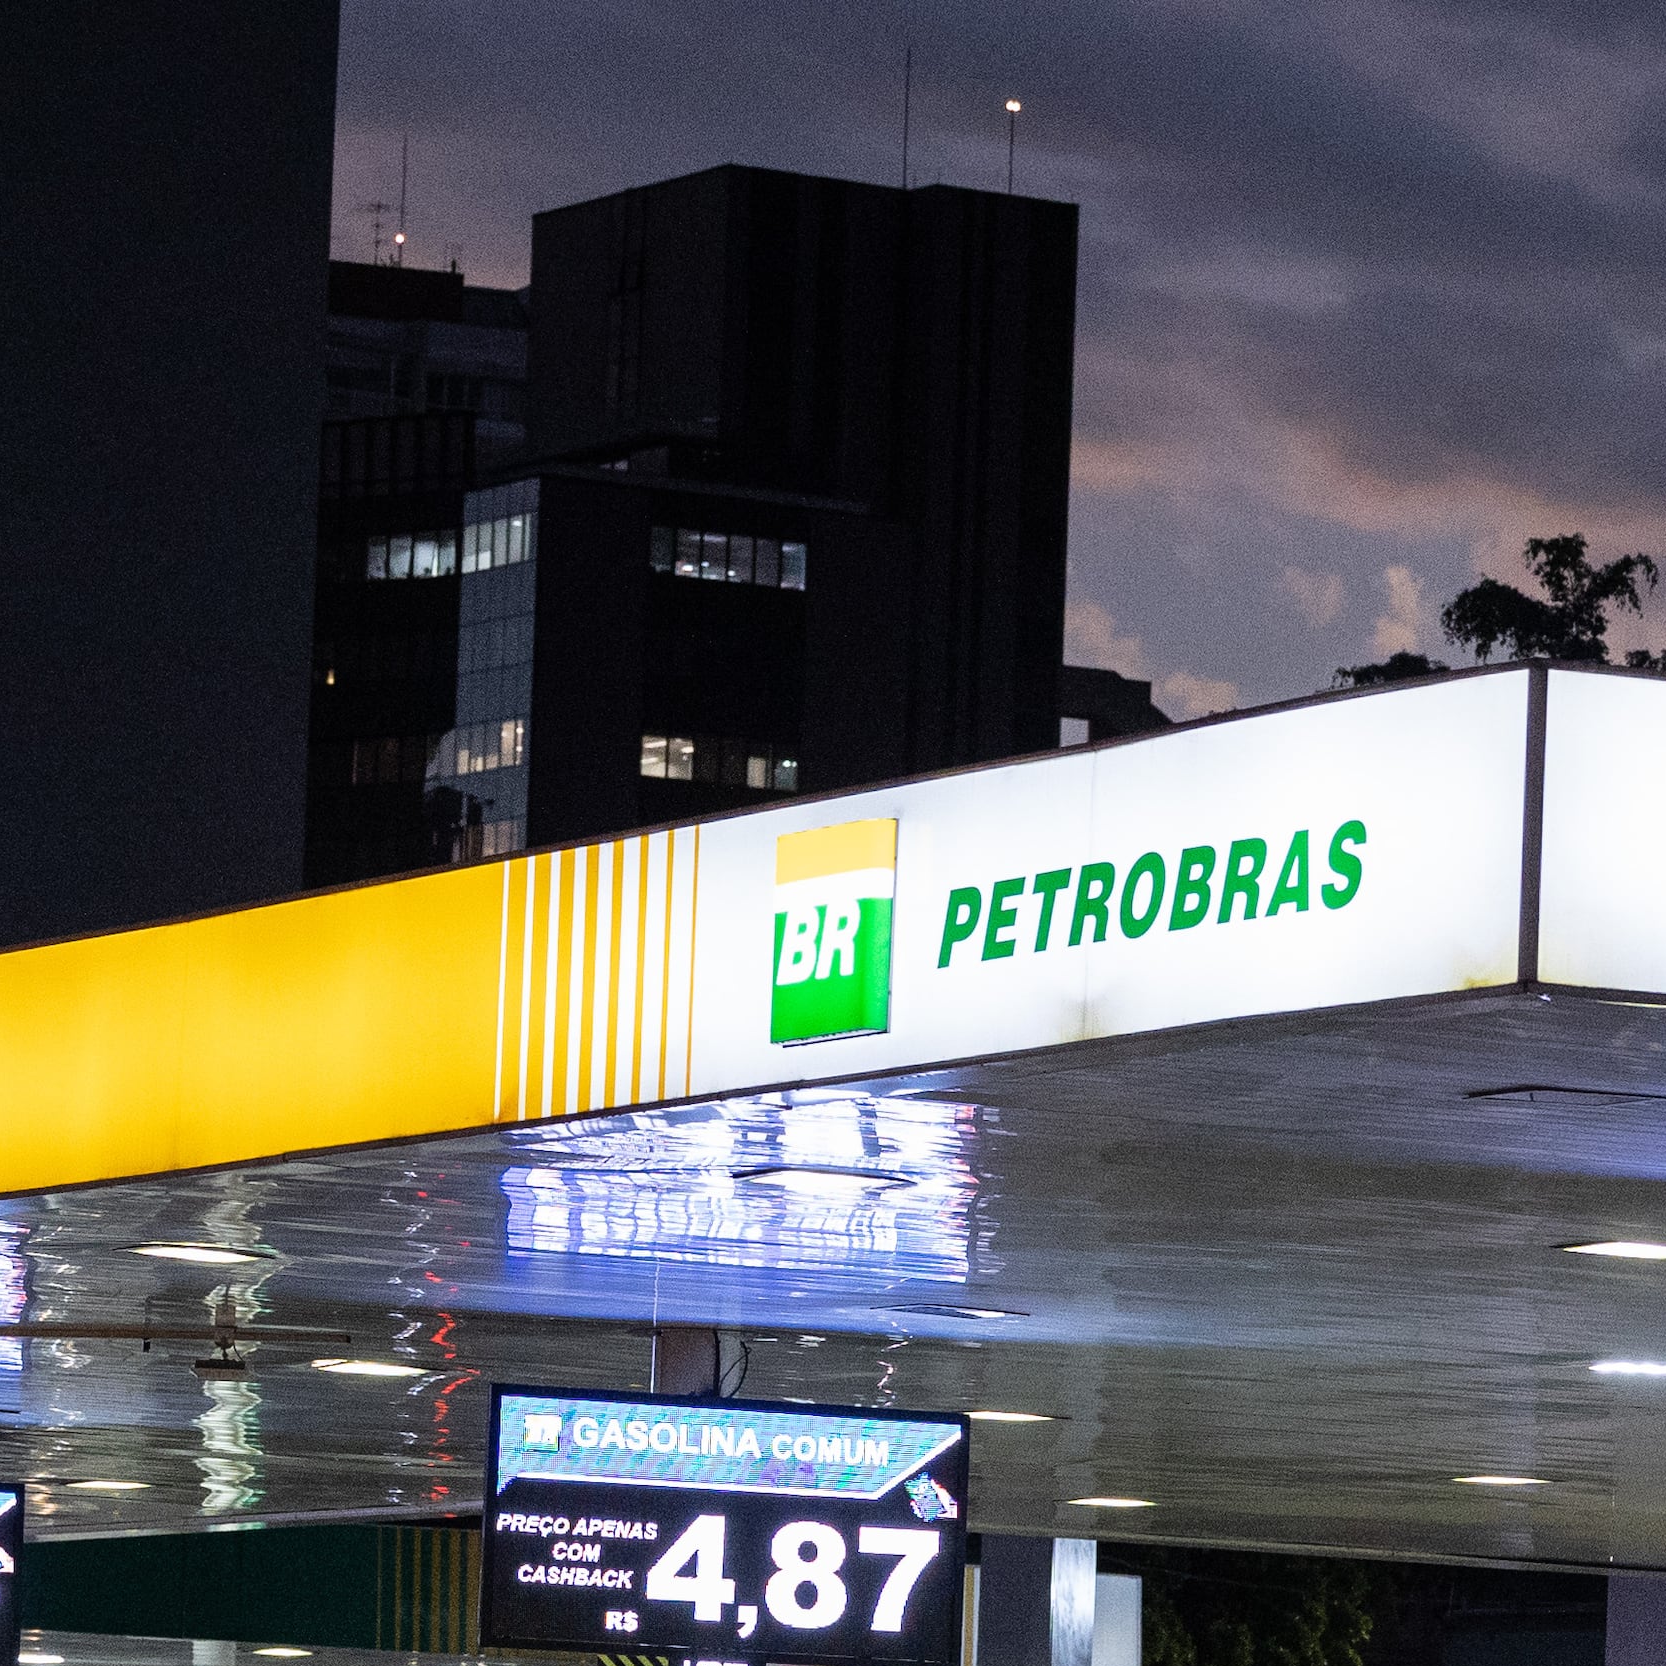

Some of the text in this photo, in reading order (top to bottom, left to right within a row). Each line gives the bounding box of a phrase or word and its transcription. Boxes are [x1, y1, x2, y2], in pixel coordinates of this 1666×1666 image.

[776, 819, 1367, 986] BR PETROBRAS
[573, 1417, 889, 1467] GASOLINA COMUM
[496, 1512, 658, 1540] PREÇO APENAS
[552, 1542, 601, 1563] COM
[517, 1565, 633, 1589] CASHBACK
[645, 1514, 941, 1639] 4,87
[605, 1610, 639, 1633] R$
